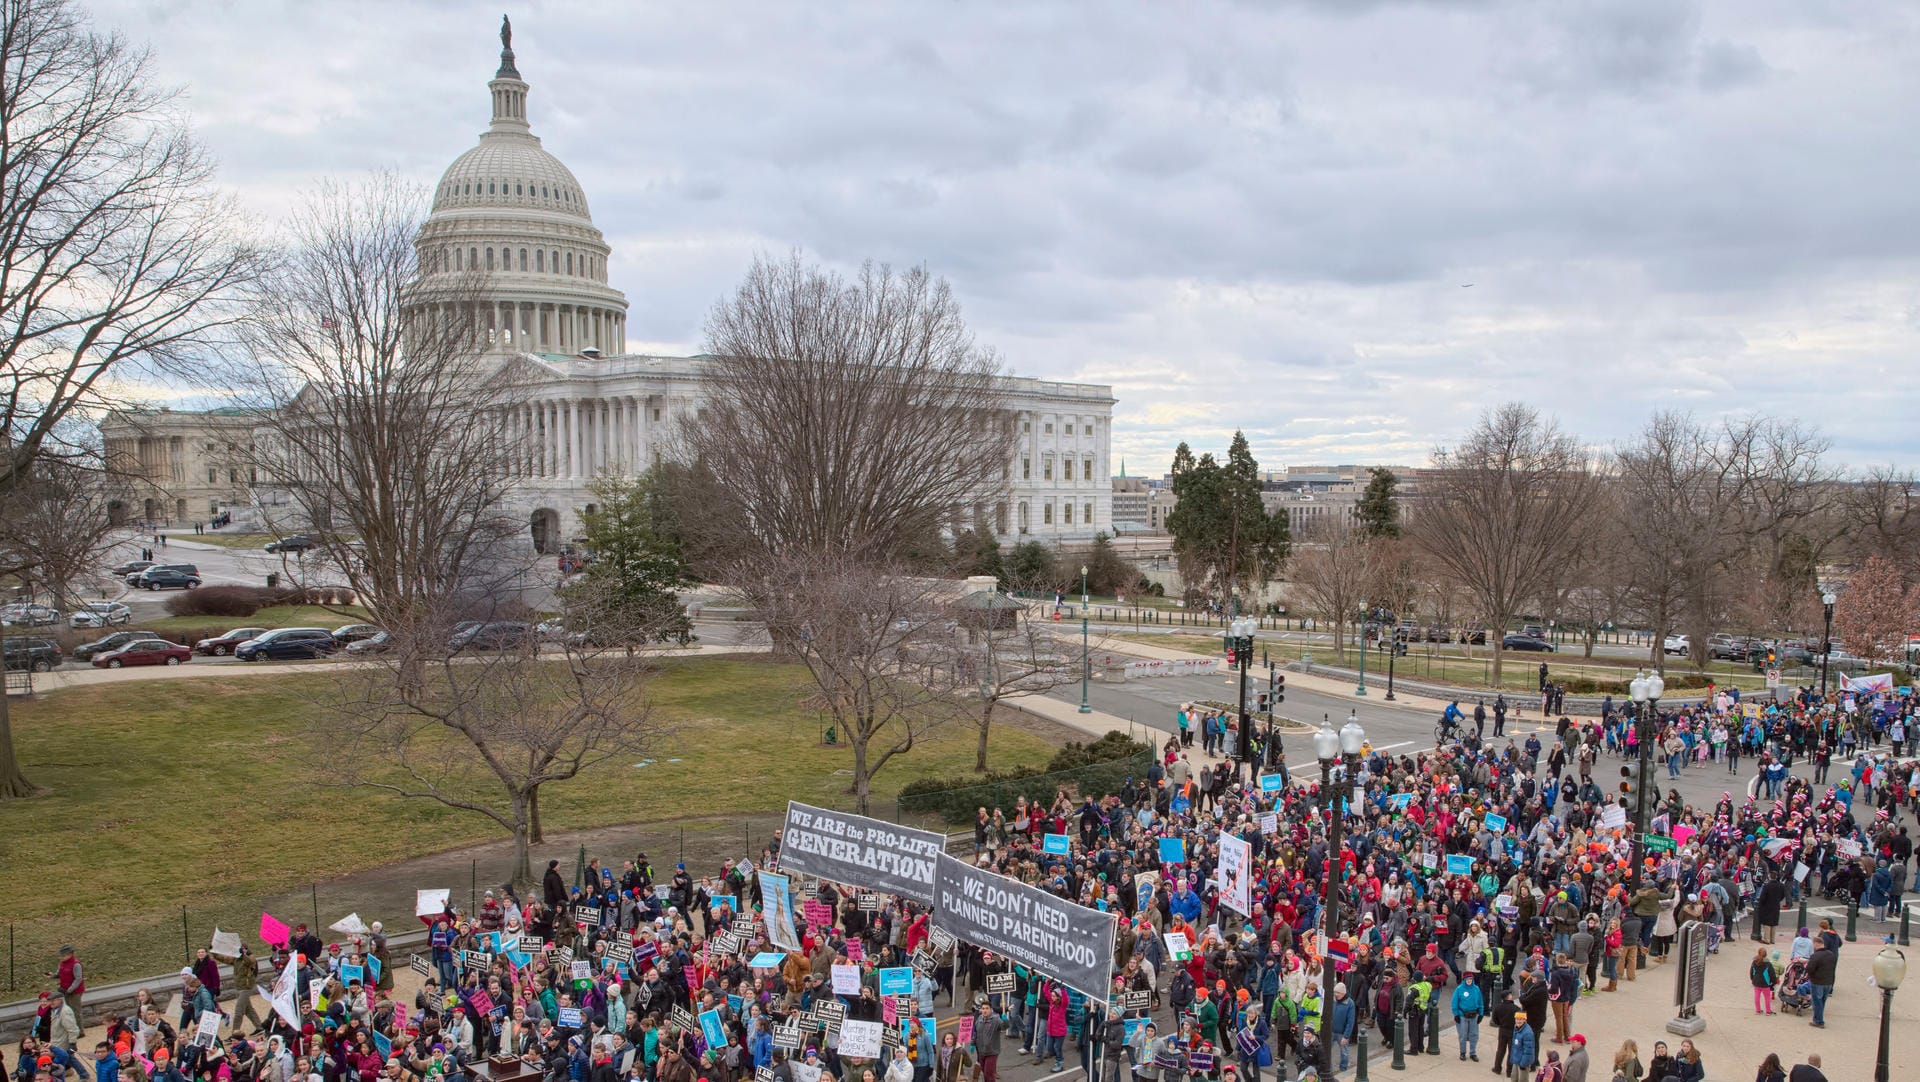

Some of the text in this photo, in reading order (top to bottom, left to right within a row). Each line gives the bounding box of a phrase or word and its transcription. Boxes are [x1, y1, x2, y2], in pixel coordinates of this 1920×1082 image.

[786, 828, 935, 884] GENERATION
[790, 809, 940, 858] WE ARE the PRO-LIFE
[1645, 835, 1669, 846] Delaware
[963, 876, 984, 901] WE
[986, 886, 1031, 916] DON'T
[1034, 903, 1069, 932] NEED
[942, 892, 1096, 968] PLANNED PARENTHOOD
[680, 1011, 692, 1020] AM
[826, 1003, 843, 1011] AM
